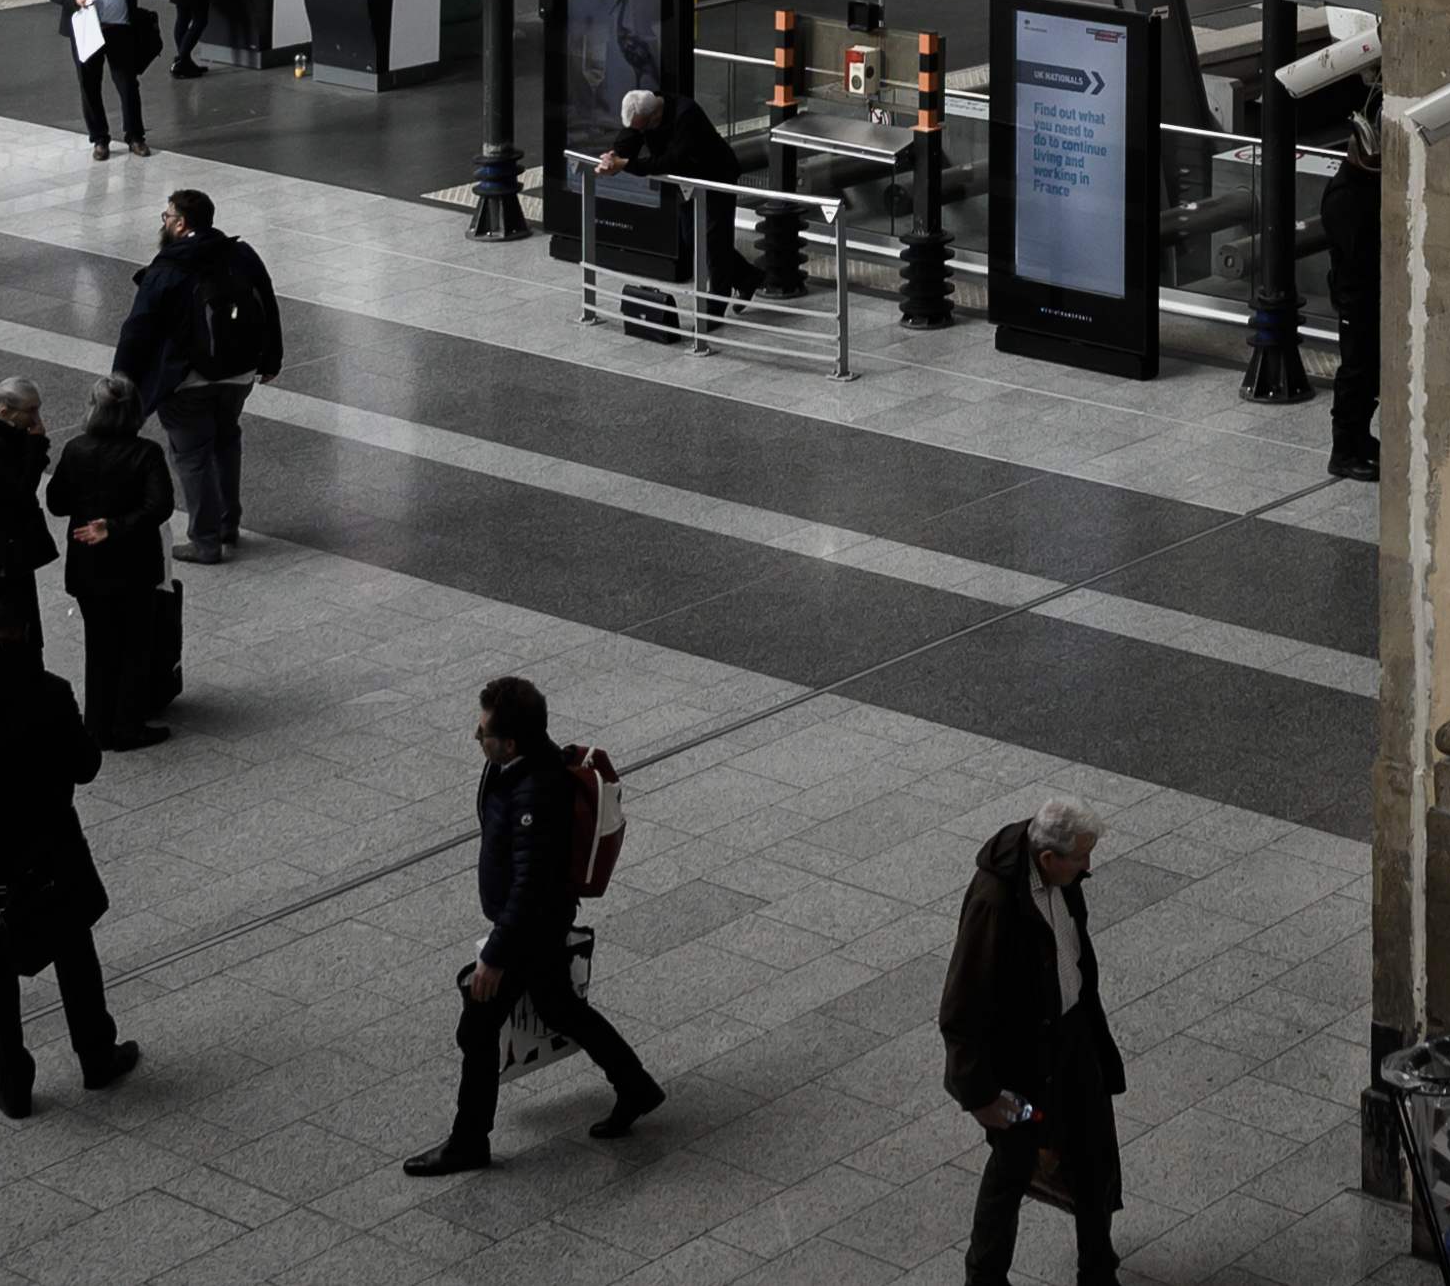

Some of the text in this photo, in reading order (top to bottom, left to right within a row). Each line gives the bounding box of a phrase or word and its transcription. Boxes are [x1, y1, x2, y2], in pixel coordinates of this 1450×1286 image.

[1034, 69, 1084, 86] UK NATIONALS
[1034, 102, 1105, 125] Find out what
[1034, 121, 1094, 139] you need to
[1034, 131, 1107, 156] do to continue
[1034, 147, 1084, 169] living and
[1033, 165, 1090, 185] working in
[1034, 180, 1070, 197] France
